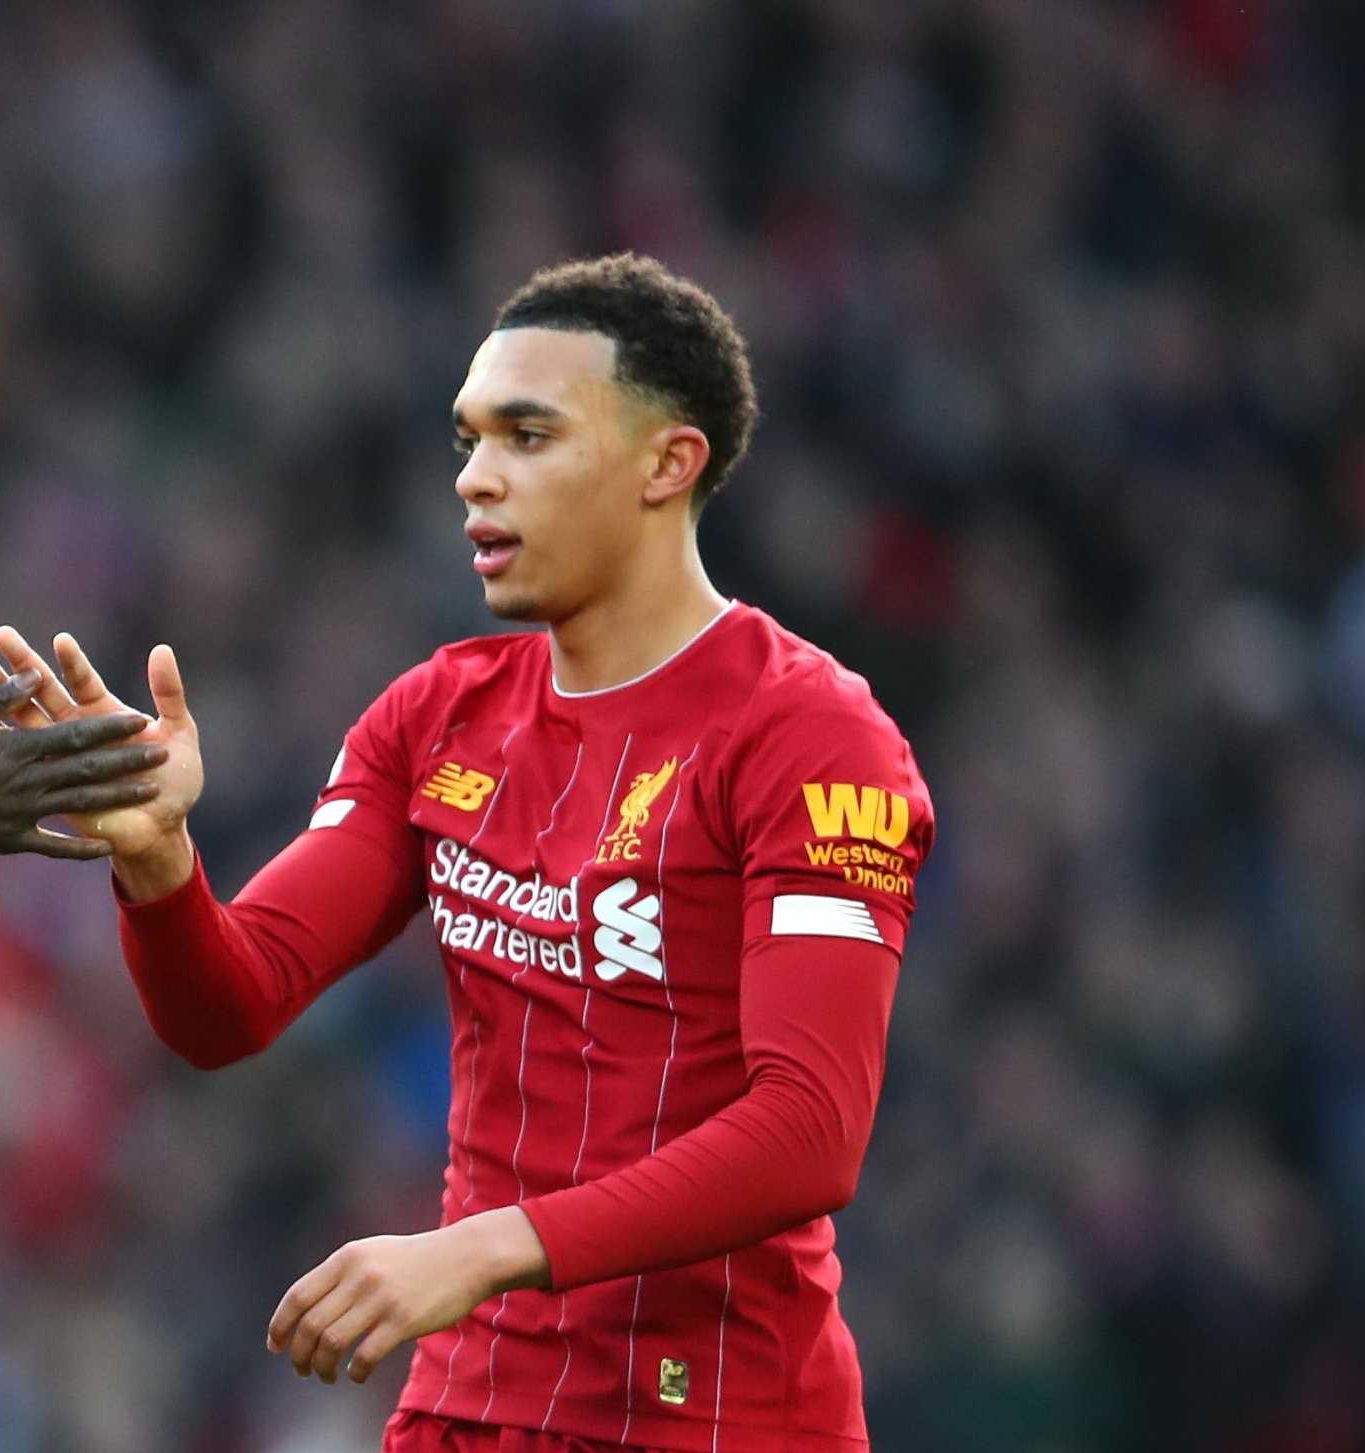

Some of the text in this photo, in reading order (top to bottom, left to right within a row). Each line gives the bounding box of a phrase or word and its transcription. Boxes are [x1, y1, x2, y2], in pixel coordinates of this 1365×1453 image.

[802, 783, 909, 849] WU
[804, 841, 904, 873] Western
[843, 866, 909, 896] Union
[428, 892, 583, 977] hartered
